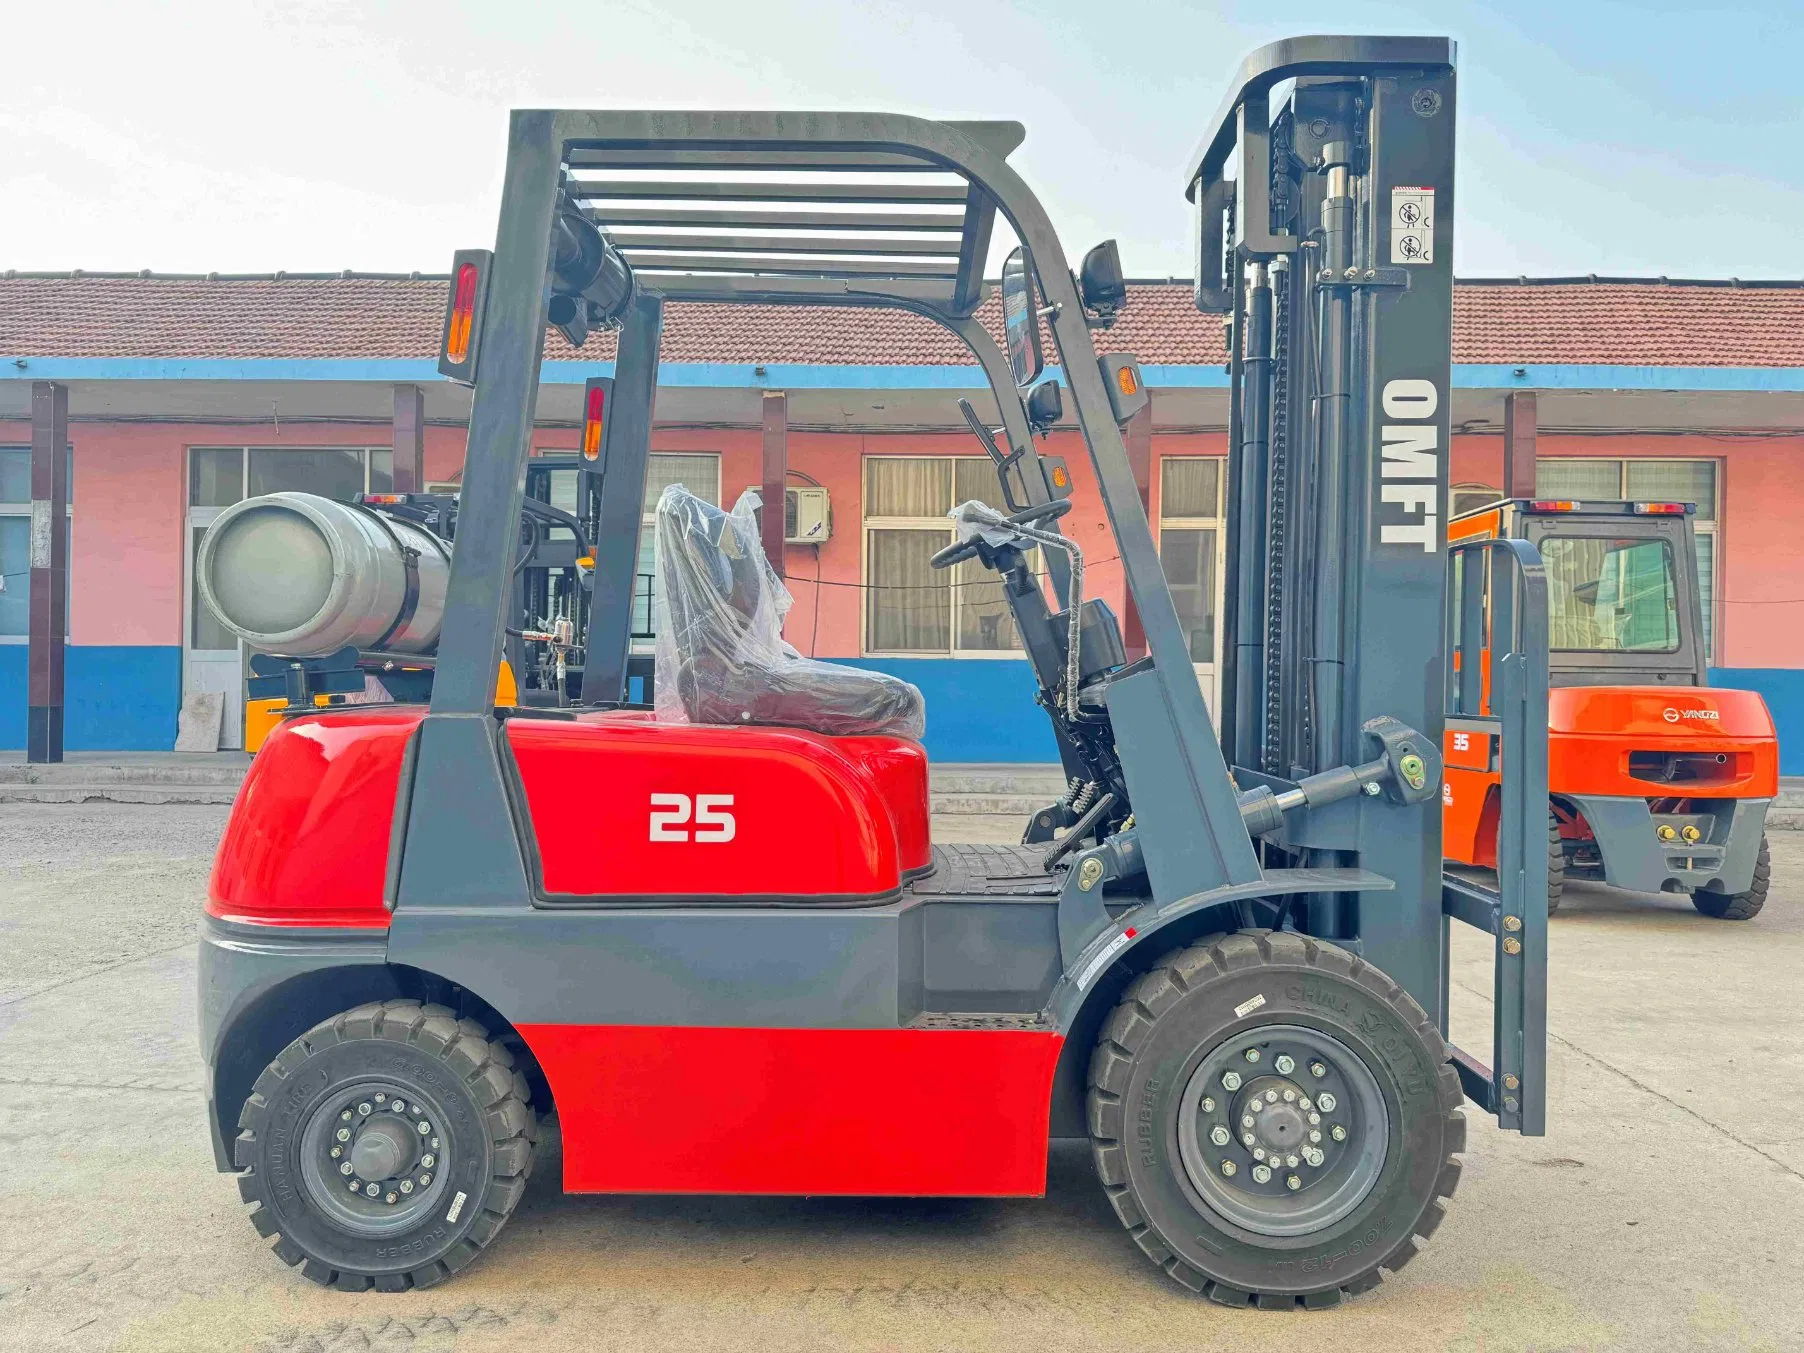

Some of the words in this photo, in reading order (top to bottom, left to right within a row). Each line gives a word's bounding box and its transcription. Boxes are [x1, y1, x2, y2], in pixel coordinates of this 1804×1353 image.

[1381, 379, 1438, 553] OMFT
[1453, 732, 1469, 751] 35
[649, 793, 736, 843] 25
